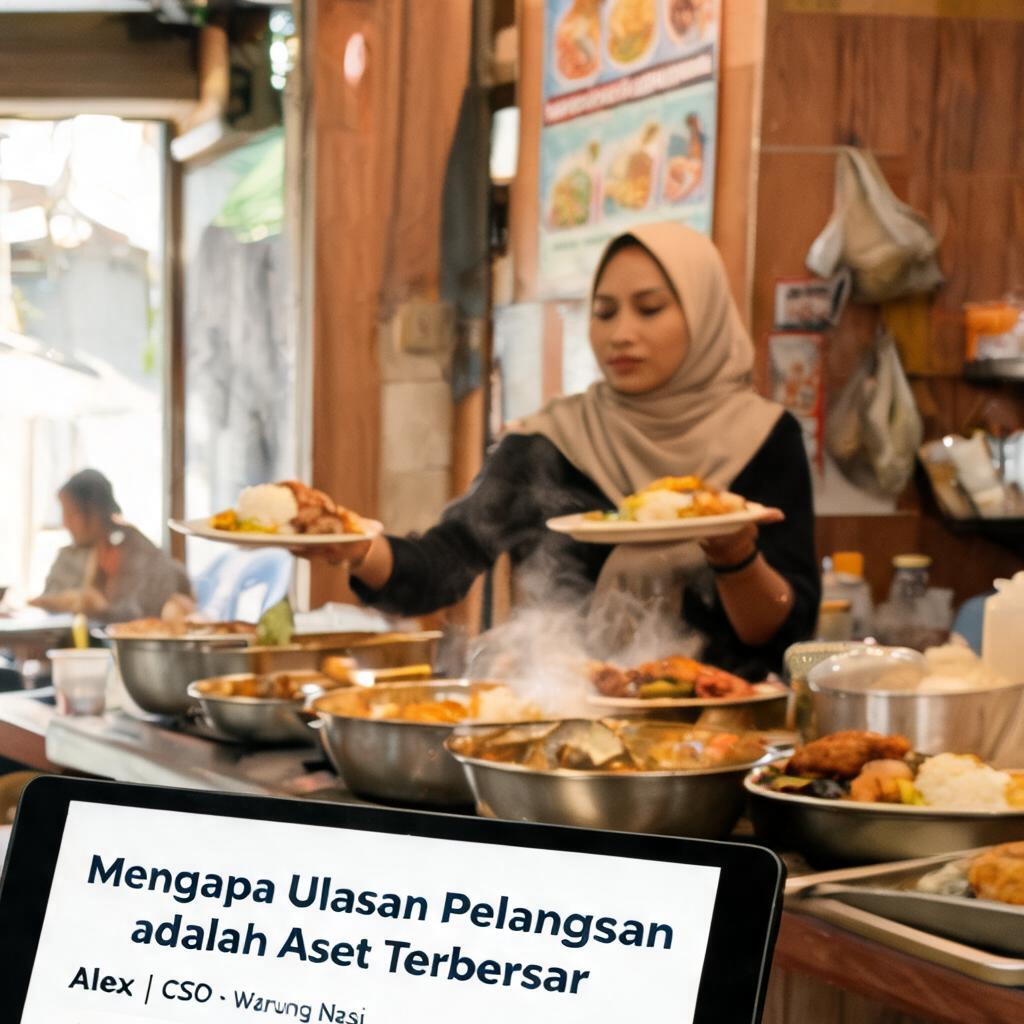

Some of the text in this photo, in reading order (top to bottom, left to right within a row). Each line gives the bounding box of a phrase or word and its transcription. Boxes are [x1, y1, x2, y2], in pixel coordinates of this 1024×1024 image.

[87, 854, 675, 950] Mengapa Ulasan Pelangsan
[68, 966, 135, 997] Alex
[161, 979, 213, 1003] CSO
[234, 990, 312, 1024] Warung
[130, 913, 591, 995] adalah Aset Terbersar
